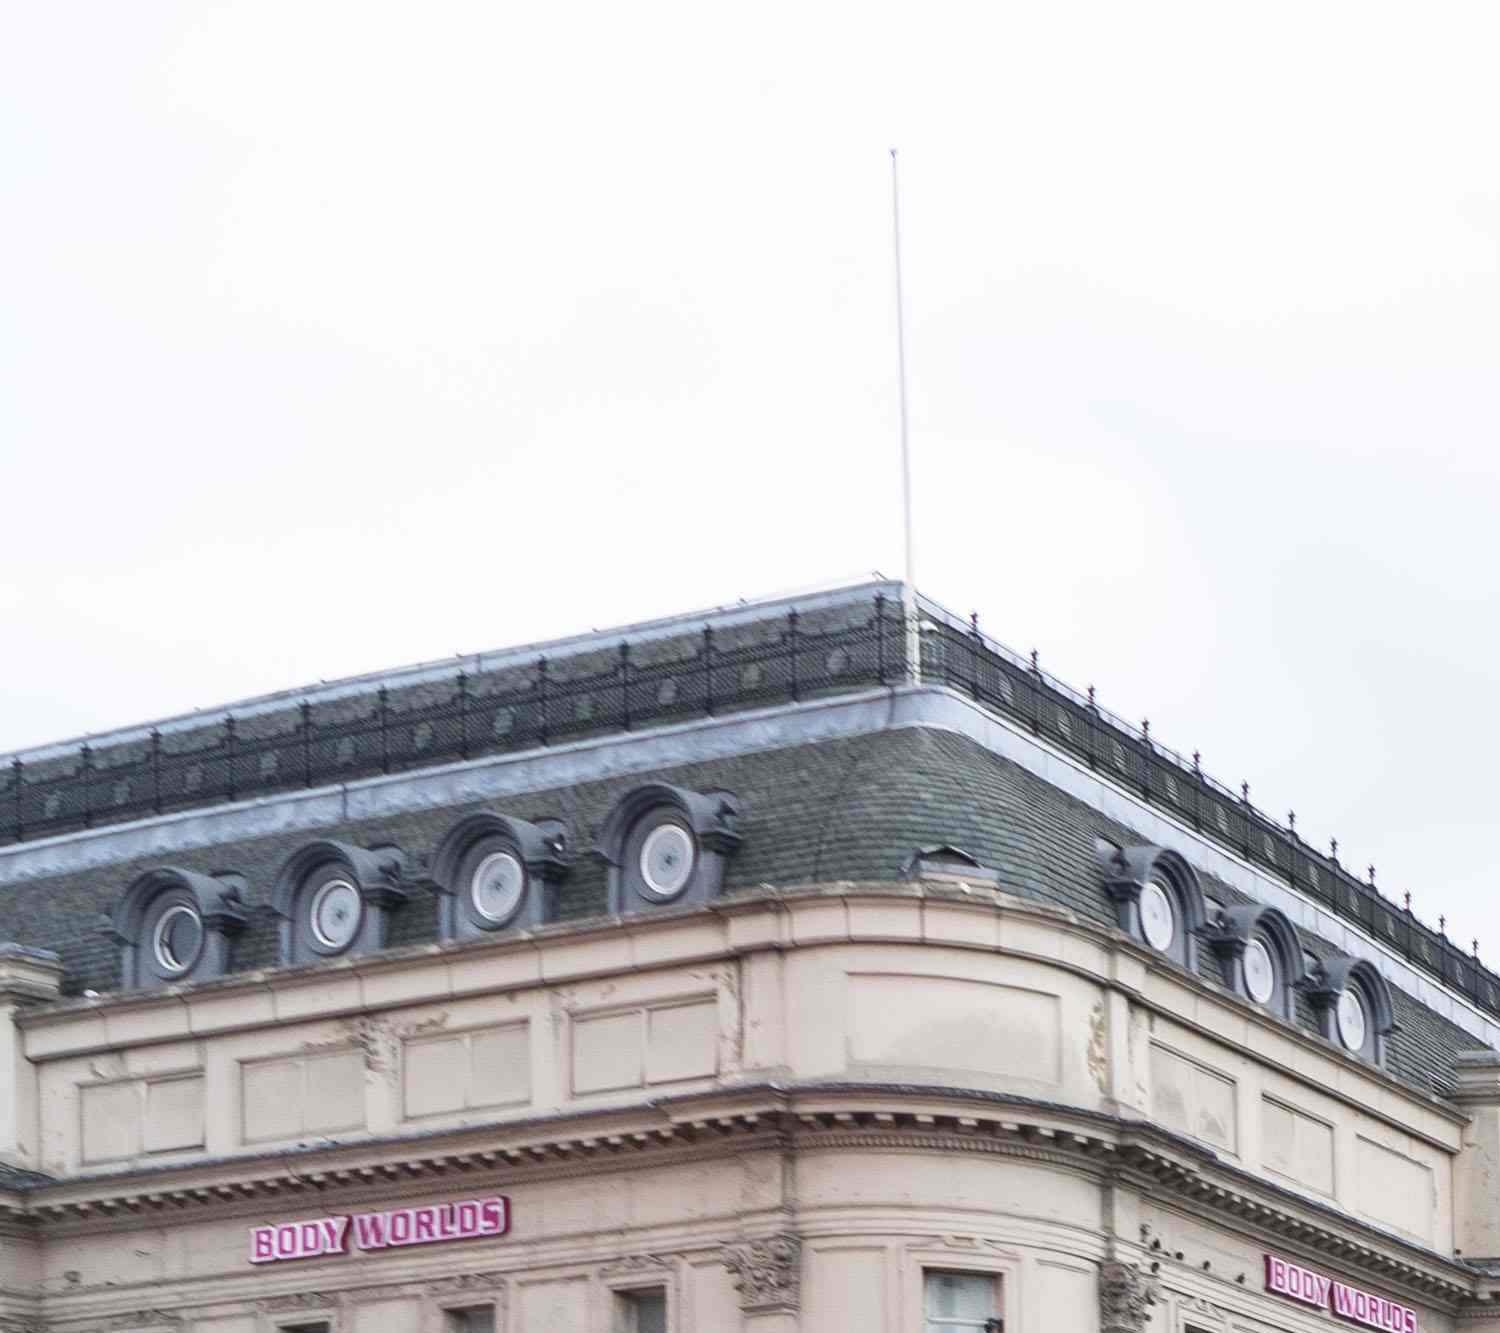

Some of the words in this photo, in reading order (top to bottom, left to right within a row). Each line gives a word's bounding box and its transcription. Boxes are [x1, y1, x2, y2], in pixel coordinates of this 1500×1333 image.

[254, 1218, 348, 1263] BODY
[352, 1199, 506, 1251] WORLDS
[1268, 1256, 1330, 1310] BODY
